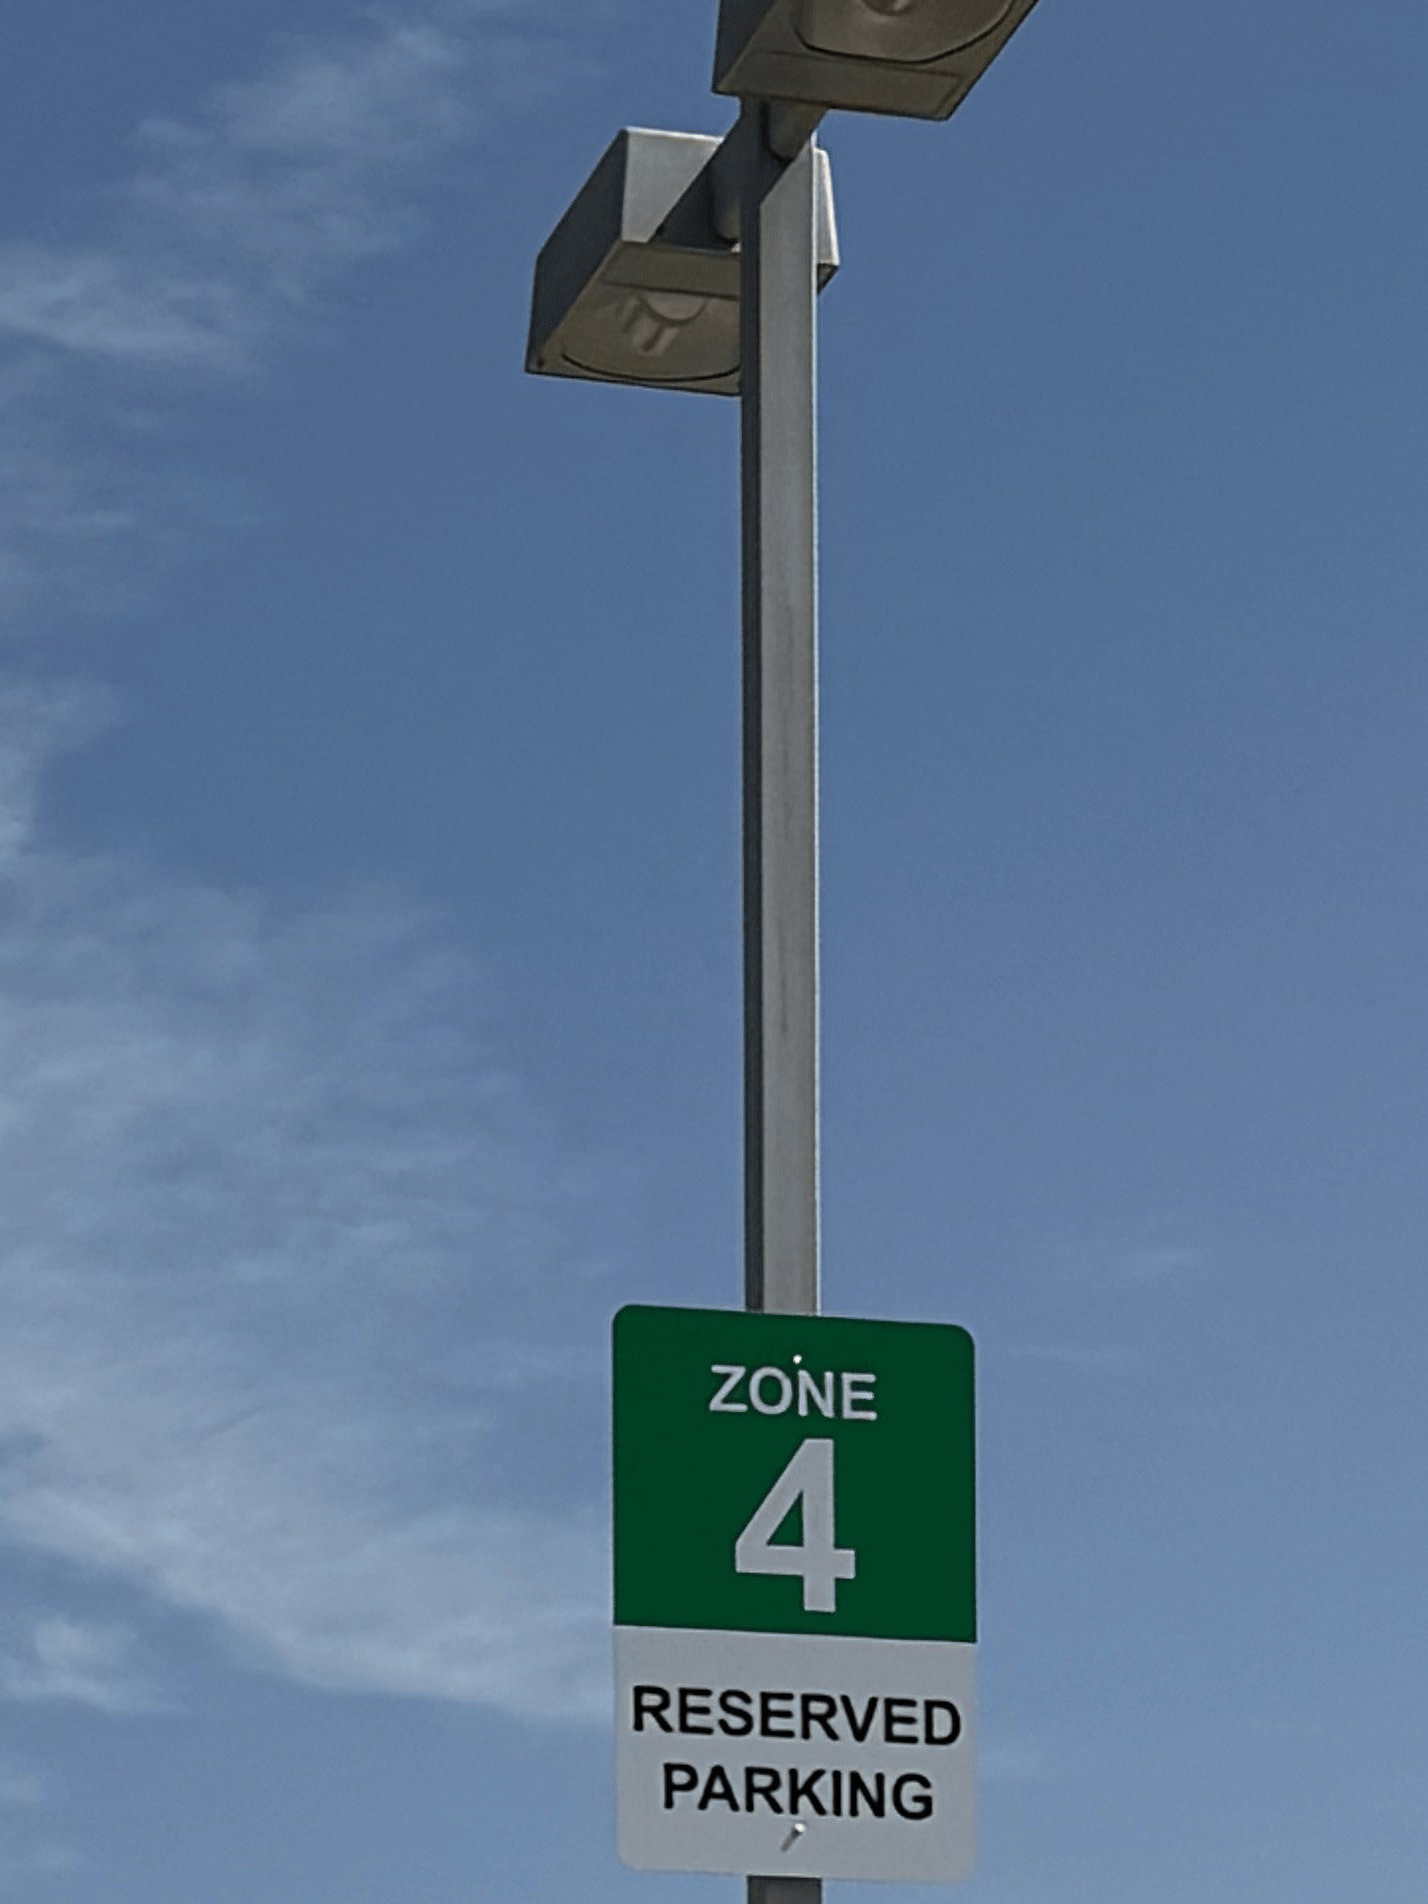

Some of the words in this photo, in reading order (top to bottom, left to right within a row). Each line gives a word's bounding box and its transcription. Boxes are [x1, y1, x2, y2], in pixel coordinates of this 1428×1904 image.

[708, 1364, 878, 1422] ZONE
[734, 1437, 856, 1613] 4
[632, 1684, 962, 1747] RESERVED
[662, 1761, 934, 1821] PARKING
